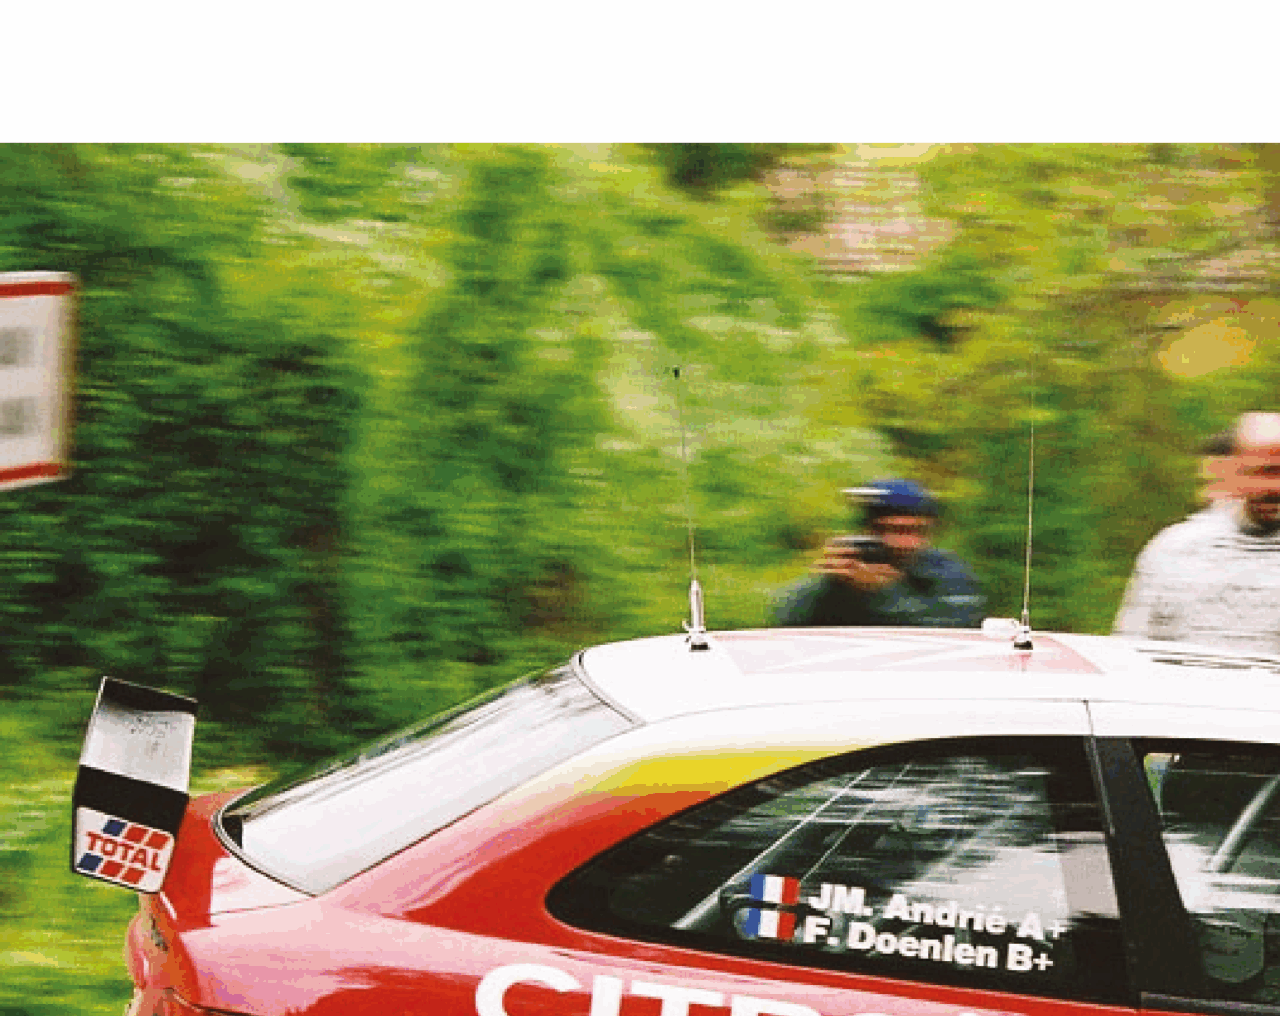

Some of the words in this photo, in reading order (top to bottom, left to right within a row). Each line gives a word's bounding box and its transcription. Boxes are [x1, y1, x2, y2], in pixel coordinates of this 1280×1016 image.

[86, 831, 161, 871] TOTAL
[807, 883, 873, 917] JM.
[1016, 912, 1067, 941] A+
[803, 915, 840, 946] F.
[1006, 943, 1054, 971] B+
